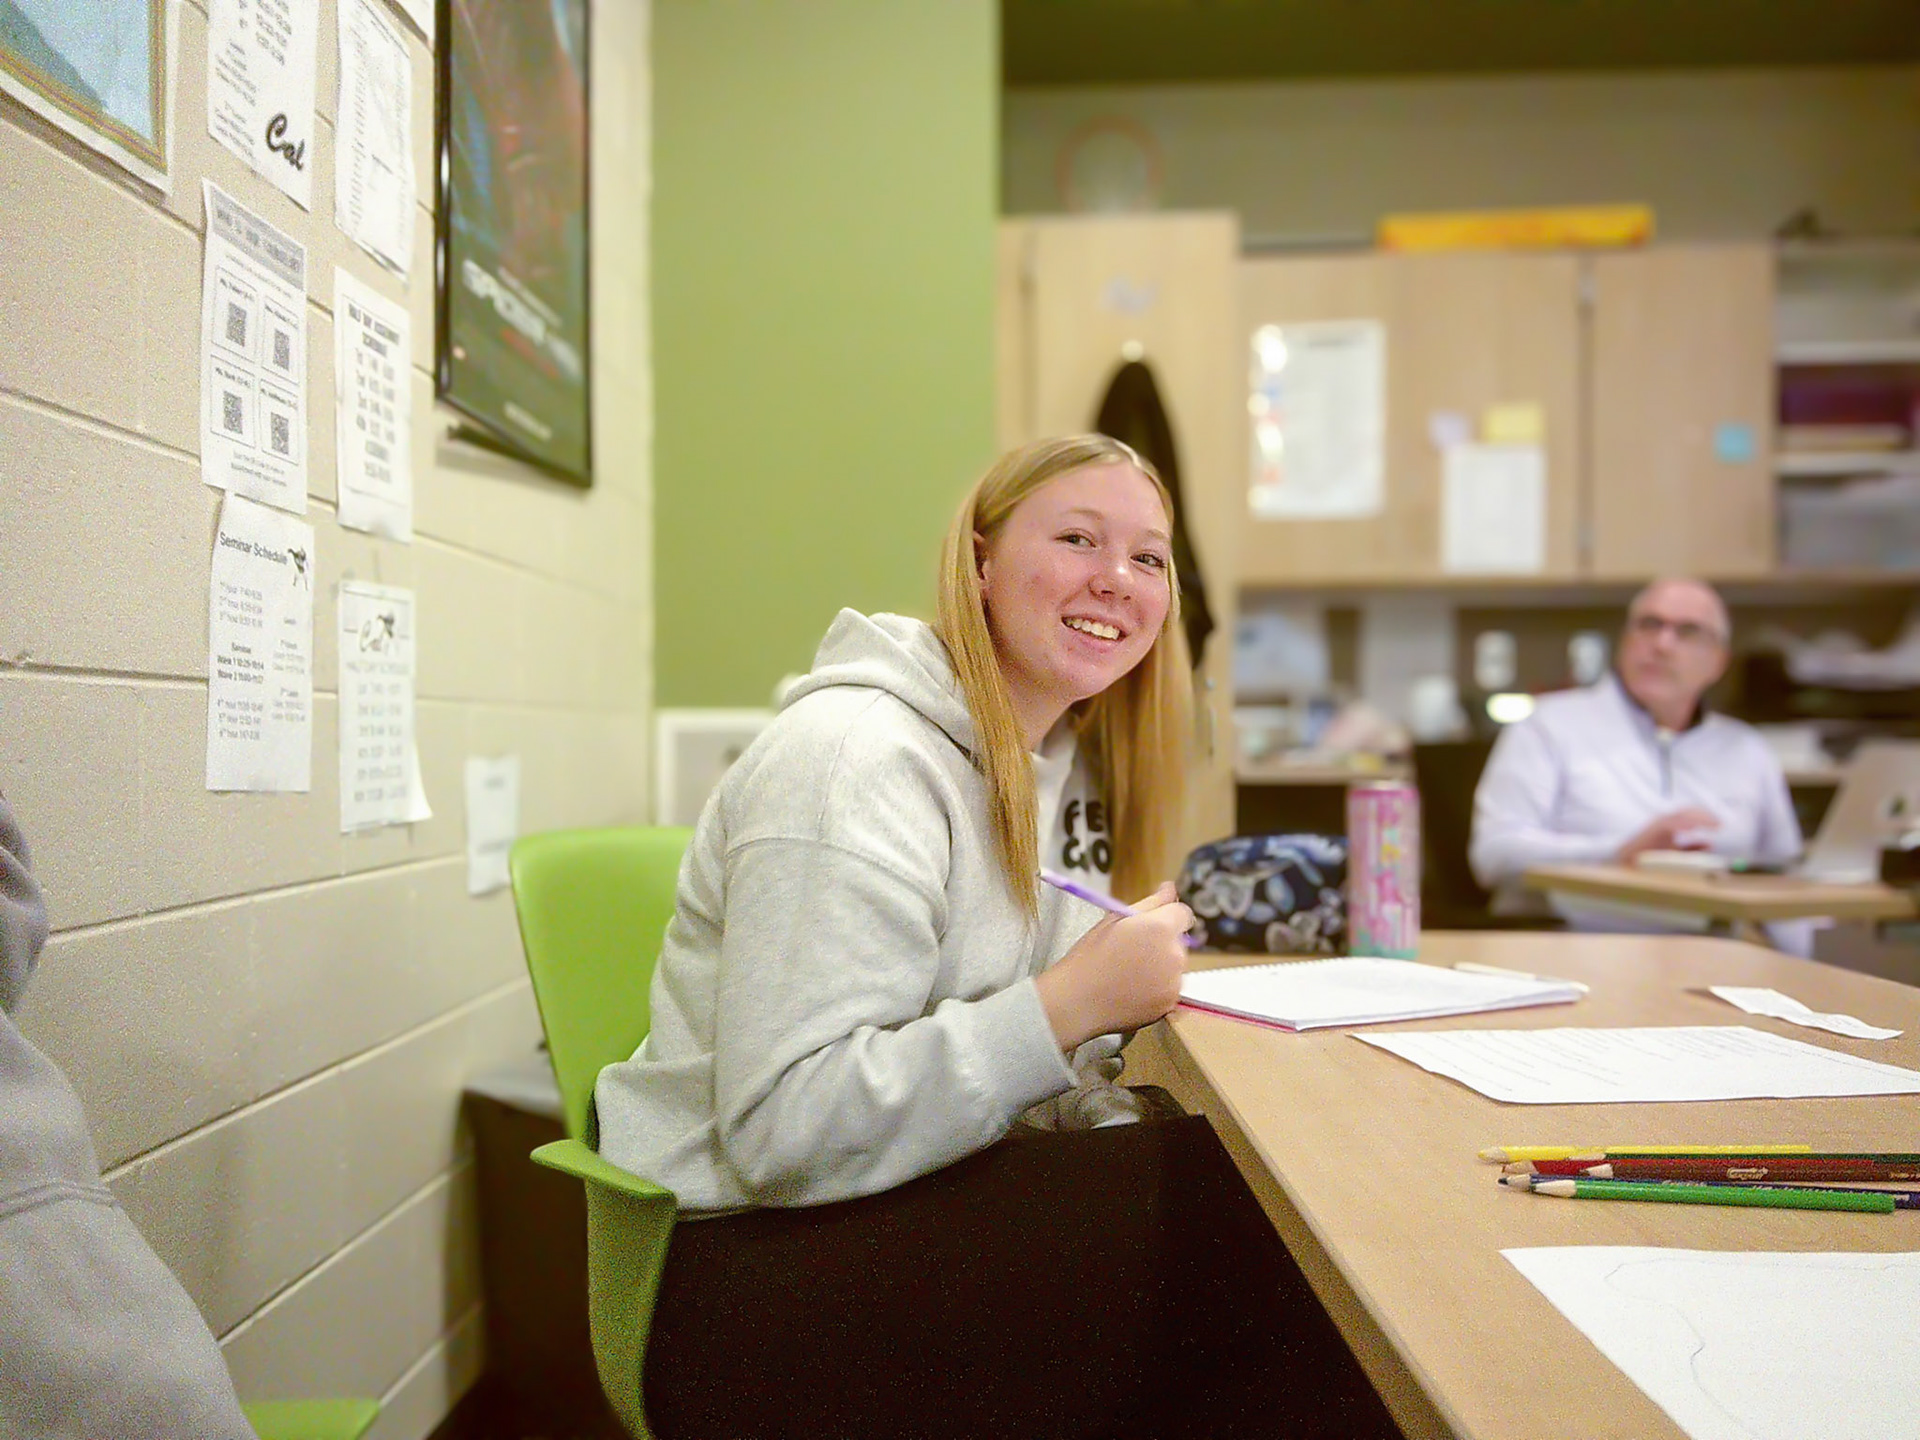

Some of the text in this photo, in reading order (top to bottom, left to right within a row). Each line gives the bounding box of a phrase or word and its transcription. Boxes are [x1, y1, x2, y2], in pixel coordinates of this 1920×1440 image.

[266, 113, 305, 170] Cal
[220, 531, 287, 565] Seminar Schedule
[1064, 800, 1104, 836] FE
